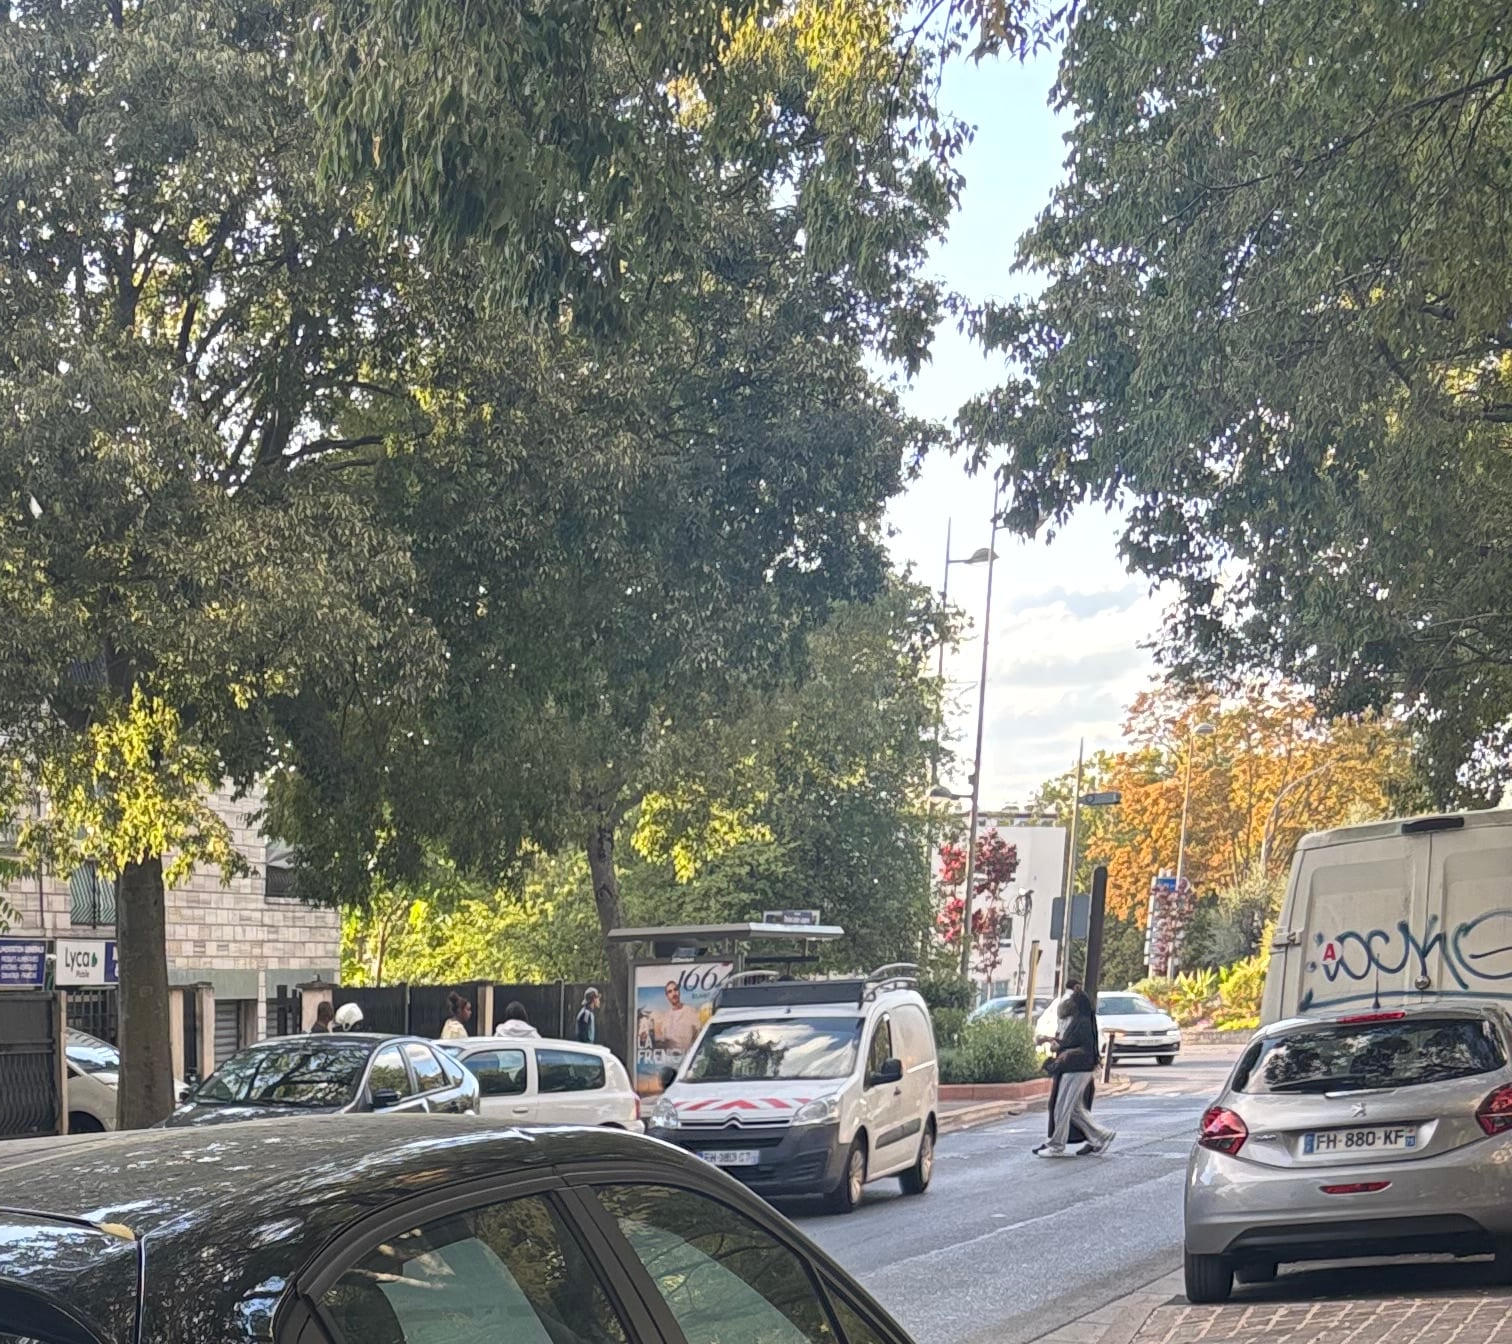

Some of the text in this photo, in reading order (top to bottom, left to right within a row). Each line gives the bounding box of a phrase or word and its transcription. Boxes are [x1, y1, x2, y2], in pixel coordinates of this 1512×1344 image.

[65, 947, 90, 972] Lyca
[1323, 943, 1336, 961] A
[638, 1037, 653, 1049] LA
[1316, 1129, 1404, 1150] FH-880-KF
